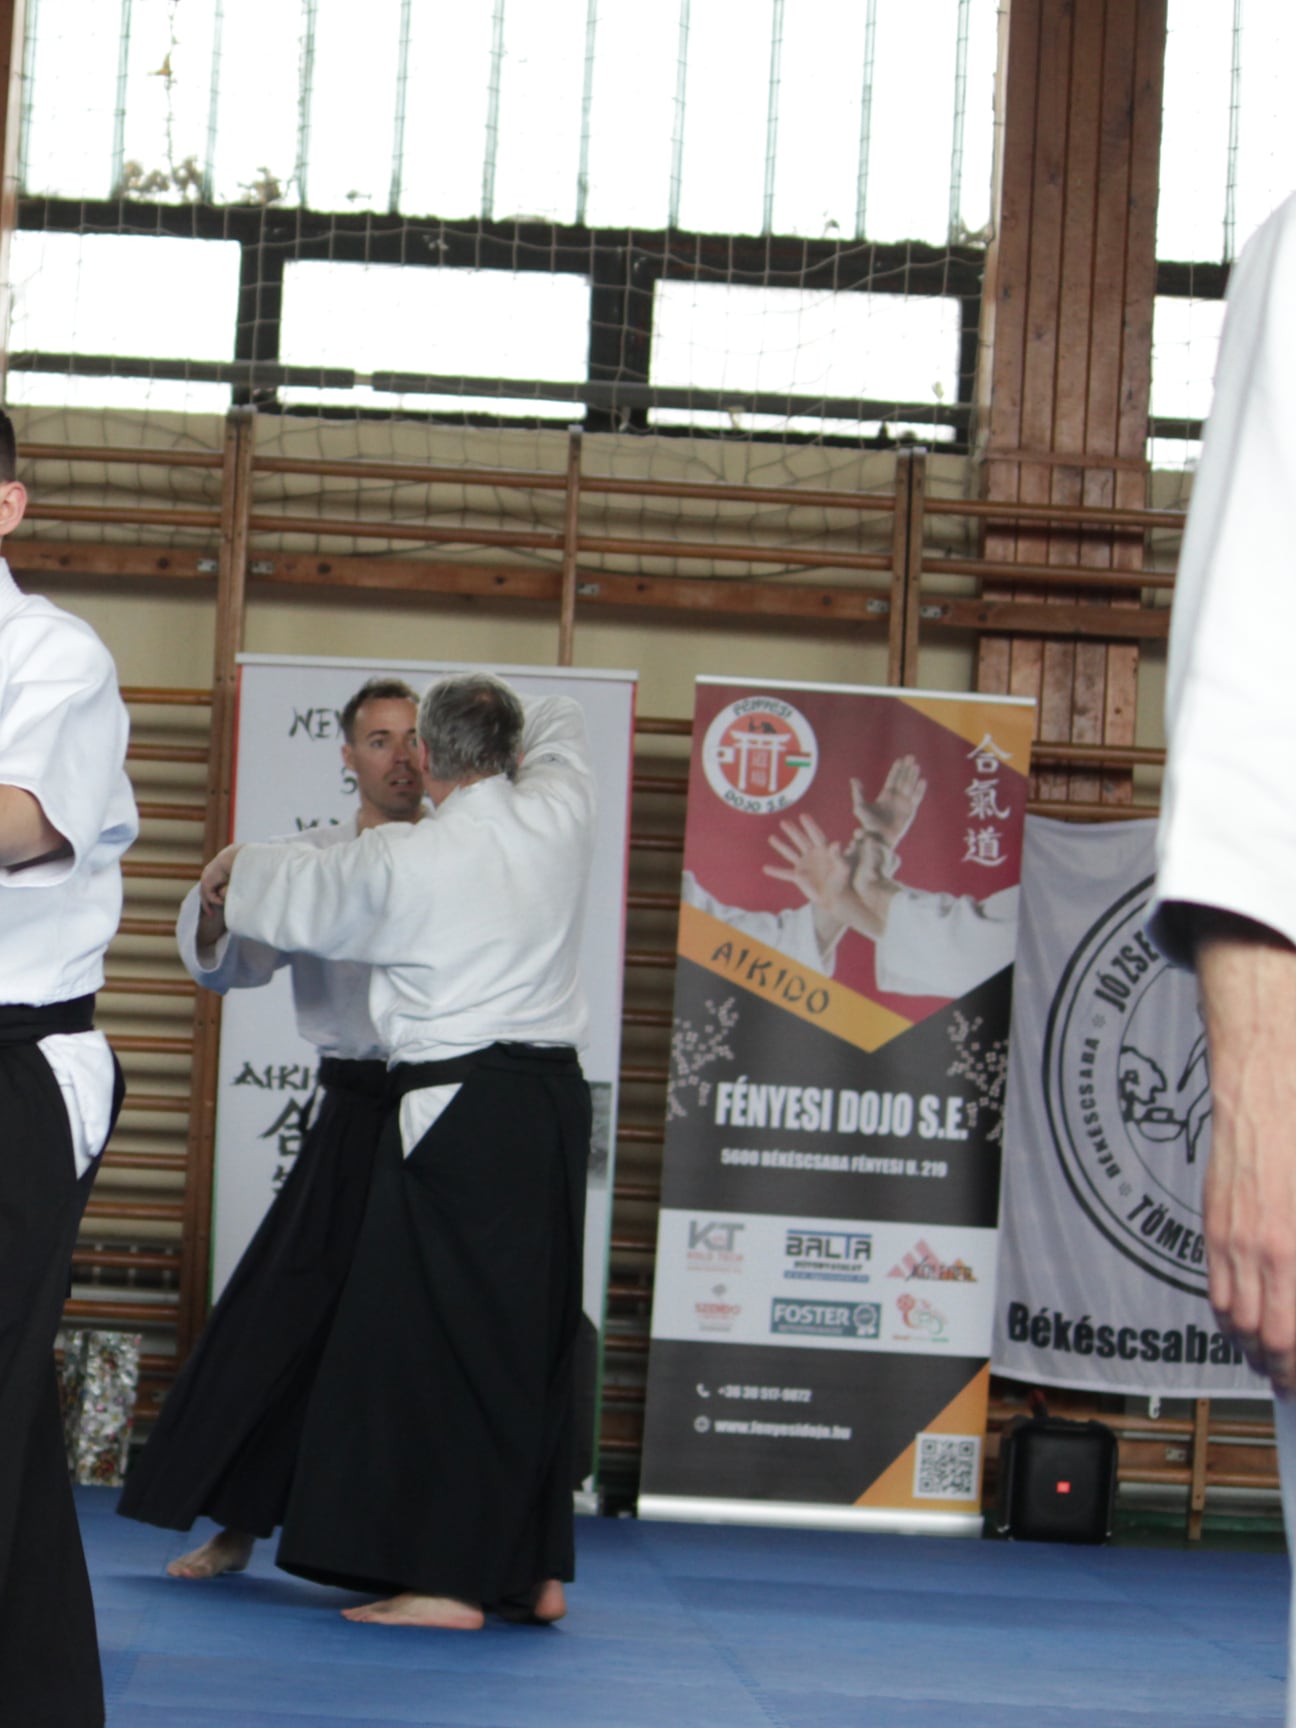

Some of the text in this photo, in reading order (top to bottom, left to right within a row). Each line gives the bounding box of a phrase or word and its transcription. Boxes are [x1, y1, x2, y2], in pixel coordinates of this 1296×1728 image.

[961, 733, 1013, 867] 合氣道
[710, 941, 830, 1015] AIKIDO
[1094, 929, 1160, 1014] JÓZSE
[232, 1061, 319, 1091] AIKI
[715, 1075, 968, 1141] FÉNYESI DOJO S.E.
[761, 1149, 849, 1172] BÉKÉSCSABA
[851, 1154, 904, 1174] FÉNYESI
[785, 1229, 873, 1261] BALTA
[1127, 1194, 1205, 1264] TÖMEG
[773, 1303, 850, 1326] FOSTER
